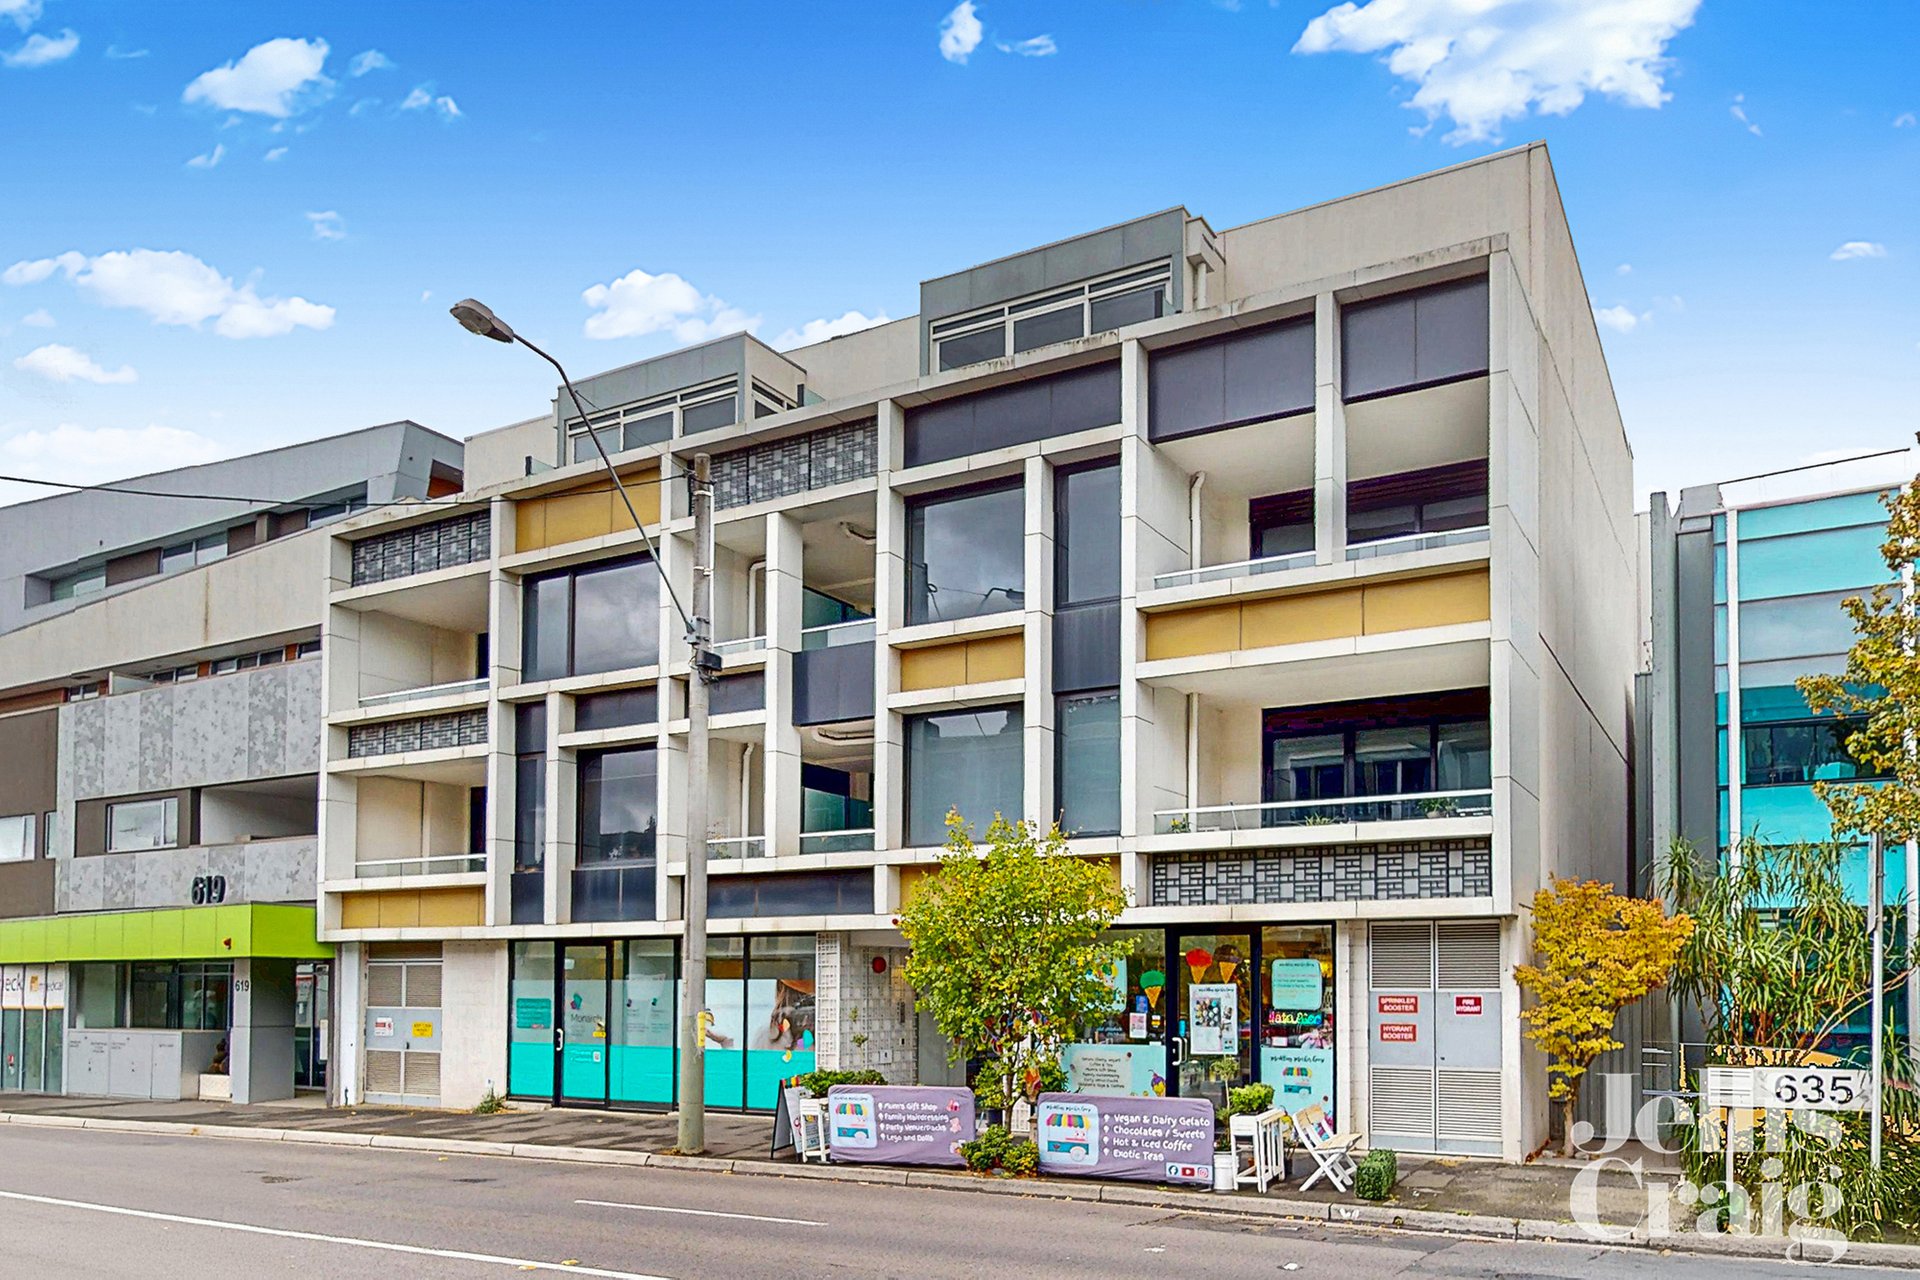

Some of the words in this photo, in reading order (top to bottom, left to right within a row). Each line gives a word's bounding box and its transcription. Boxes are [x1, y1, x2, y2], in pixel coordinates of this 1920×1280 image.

[191, 875, 226, 905] 619
[235, 980, 250, 992] 619
[1775, 1074, 1854, 1105] 635
[906, 1103, 920, 1112] Gift
[920, 1103, 938, 1112] Shop
[884, 1113, 906, 1123] Family
[906, 1113, 949, 1123] Hairdressing
[1113, 1115, 1141, 1125] Vegan
[1143, 1116, 1150, 1124] &
[1152, 1115, 1177, 1128] Dairy
[1179, 1117, 1211, 1128] Gelato
[885, 1124, 904, 1133] Party
[1113, 1126, 1163, 1137] Chocolates
[1172, 1130, 1206, 1140] Sweets
[886, 1134, 902, 1143] Lego
[903, 1134, 916, 1142] and
[917, 1134, 934, 1142] Dolls
[1113, 1138, 1129, 1147] Hot
[1141, 1139, 1161, 1149] Iced
[1162, 1139, 1193, 1152] Coffee
[1113, 1149, 1141, 1159] Exotic
[1143, 1150, 1165, 1161] Teas
